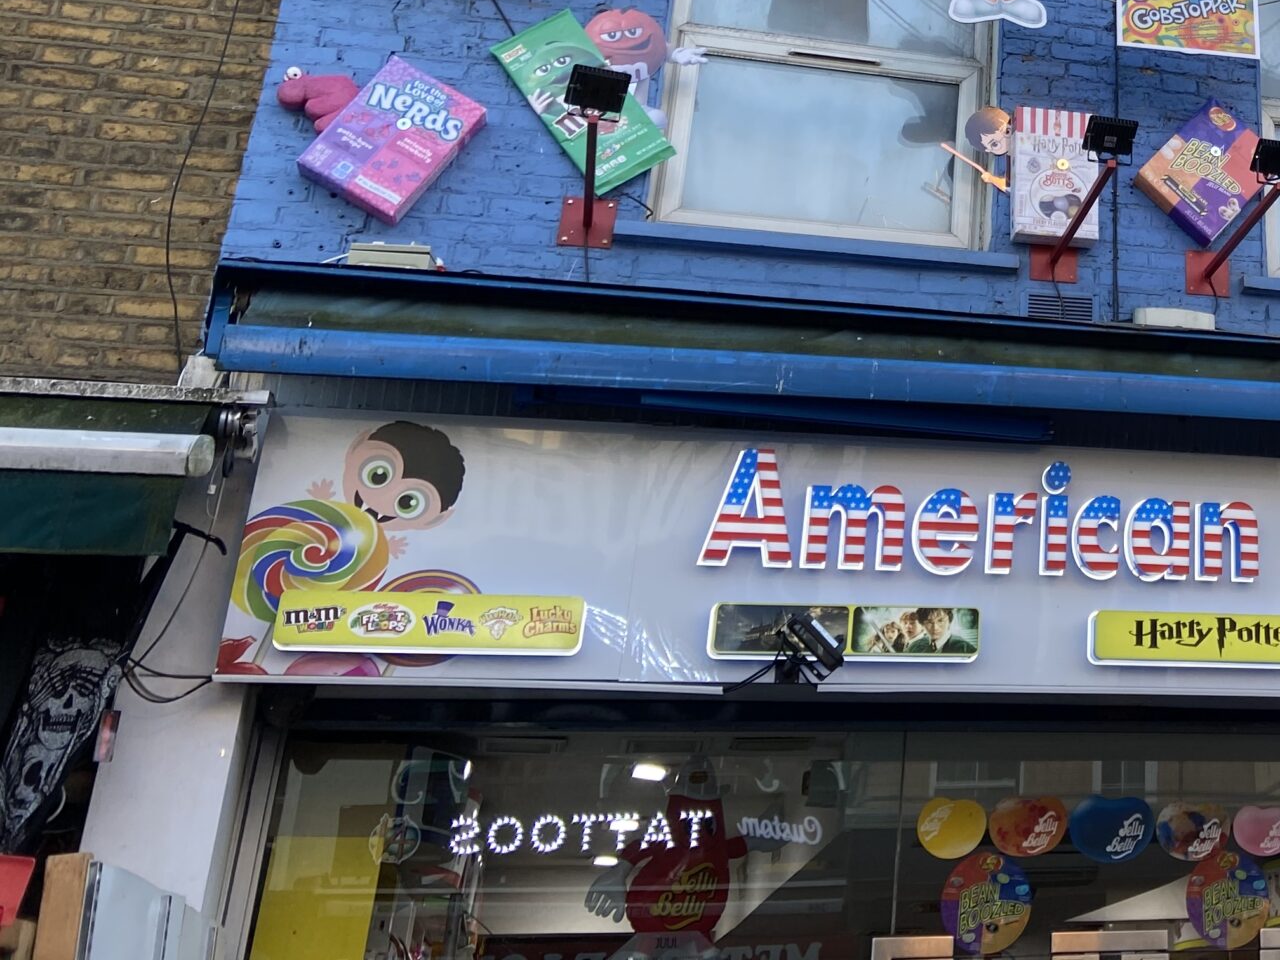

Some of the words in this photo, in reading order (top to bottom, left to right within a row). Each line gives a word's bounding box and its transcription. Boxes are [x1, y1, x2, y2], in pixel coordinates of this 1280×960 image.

[1183, 137, 1231, 168] BEAN
[1169, 155, 1241, 195] BOOZLED
[696, 448, 1260, 584] American
[423, 615, 476, 637] WONKA
[523, 620, 577, 638] Charms
[530, 606, 572, 622] Lucky
[1129, 618, 1213, 649] Harry
[1119, 817, 1145, 840] Jelly
[1199, 821, 1222, 840] Jelly
[1106, 836, 1138, 853] Belly
[1187, 838, 1217, 854] Belly
[671, 865, 719, 897] Jelly
[959, 878, 1000, 914] BEAN
[1203, 878, 1240, 910] BEAN
[652, 892, 707, 922] Belly
[959, 901, 1025, 936] BOOZLED
[1203, 897, 1265, 934] BOOZLED
